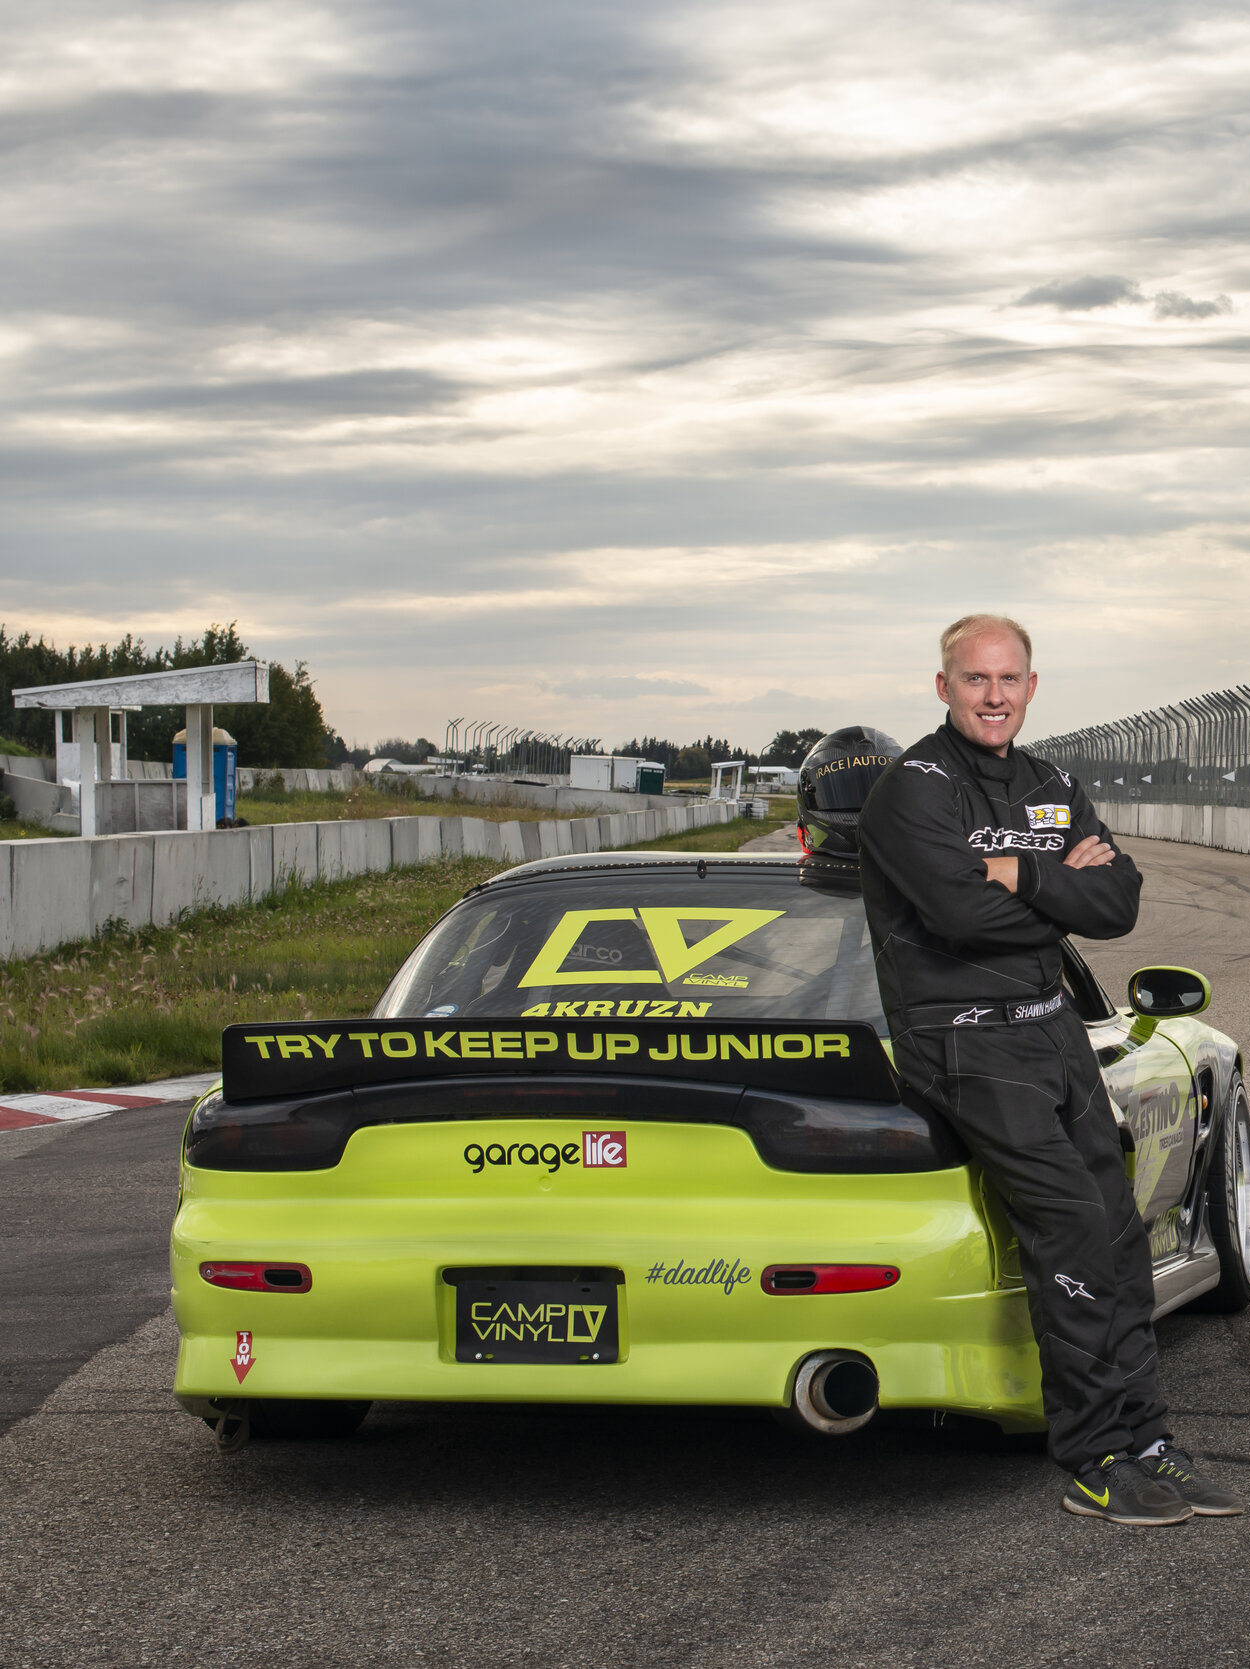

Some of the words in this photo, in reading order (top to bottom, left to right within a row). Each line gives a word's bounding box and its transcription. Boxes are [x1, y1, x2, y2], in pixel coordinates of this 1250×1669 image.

[570, 944, 622, 963] arco
[690, 972, 748, 981] CAMP
[520, 1000, 712, 1018] 4KRUZN
[1015, 1002, 1044, 1019] SHAWN
[244, 1034, 341, 1059] TRY
[348, 1031, 417, 1058] TO
[424, 1031, 558, 1060] KEEP
[567, 1032, 640, 1060] UP
[649, 1033, 850, 1060] JUNIOR
[464, 1142, 580, 1174] garage
[584, 1133, 624, 1165] life
[644, 1258, 752, 1296] #dadlife
[471, 1302, 566, 1322] CAMP
[471, 1322, 564, 1342] VINYL
[236, 1332, 250, 1366] TOW
